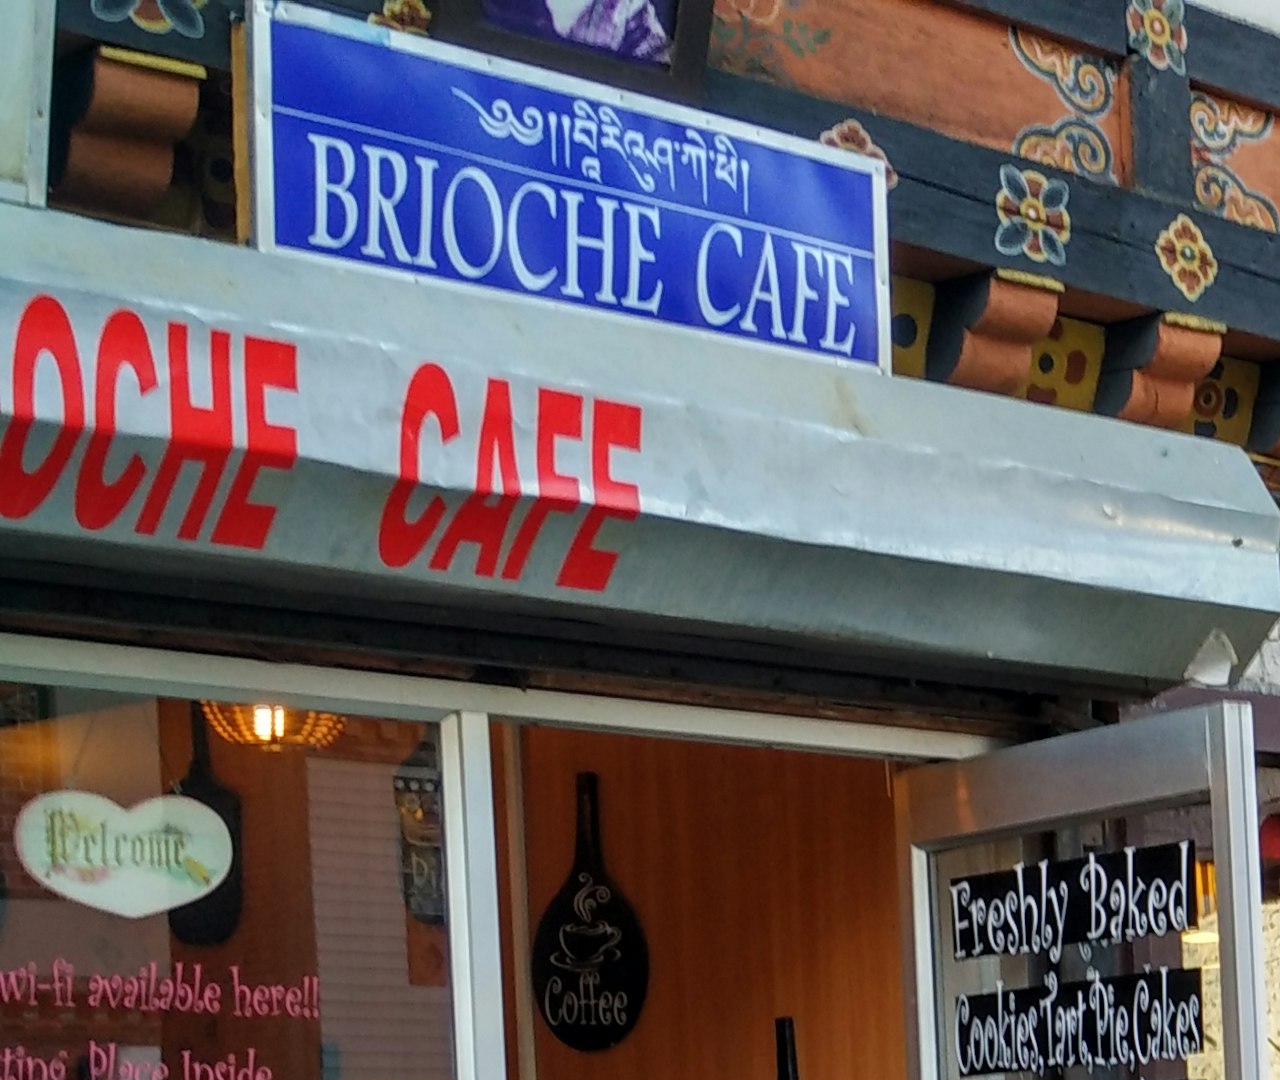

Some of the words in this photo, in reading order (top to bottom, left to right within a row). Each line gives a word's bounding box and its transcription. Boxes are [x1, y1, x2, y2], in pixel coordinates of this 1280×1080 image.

[307, 133, 663, 316] BRIOCHE
[696, 223, 856, 355] CAFE
[0, 294, 298, 549] OCHE
[378, 362, 643, 592] CAFE
[43, 807, 187, 877] Welcome
[950, 858, 1069, 964] Freshly
[1079, 839, 1192, 943] Baked
[88, 961, 222, 1014] available
[229, 965, 320, 1018] here!!
[544, 972, 628, 1027] Coffee
